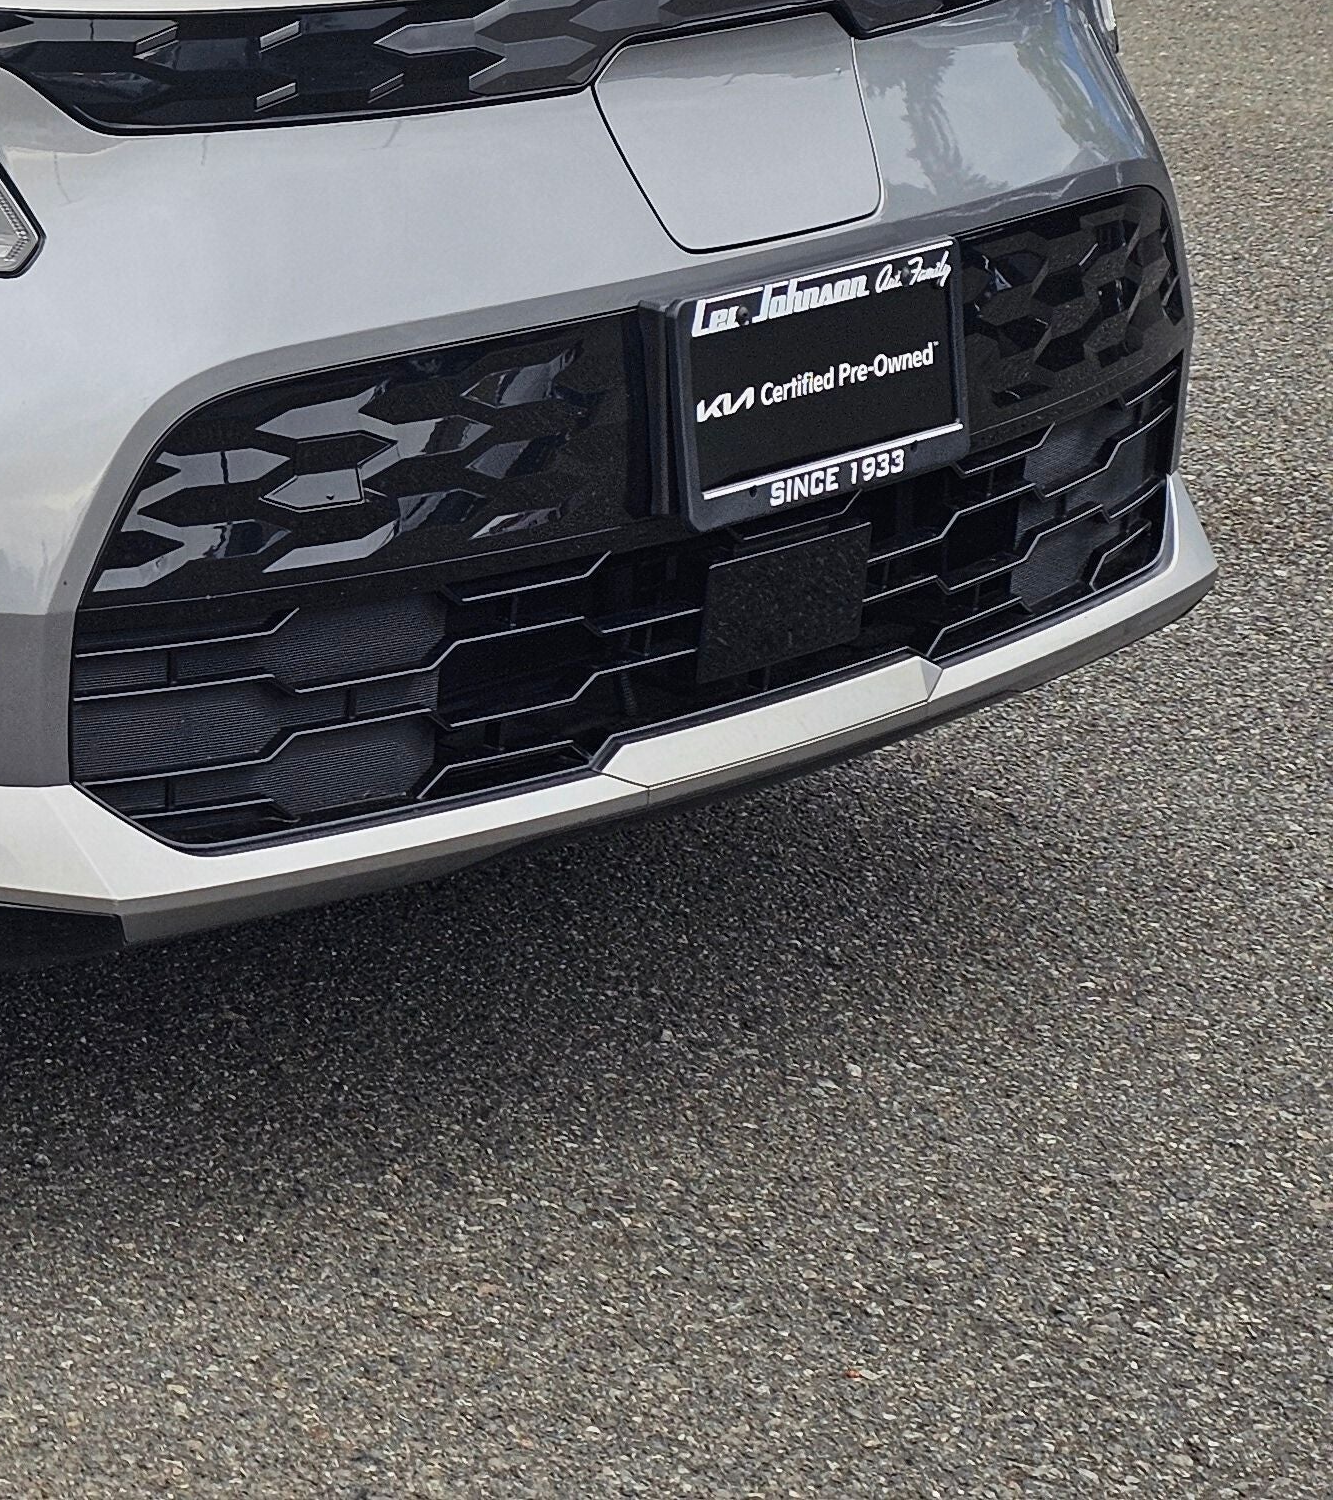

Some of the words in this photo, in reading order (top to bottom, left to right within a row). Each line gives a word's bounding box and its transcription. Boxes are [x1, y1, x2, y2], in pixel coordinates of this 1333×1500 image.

[752, 275, 870, 324] Johnson
[875, 263, 905, 293] Aut
[908, 250, 952, 287] Family
[696, 386, 755, 423] KIA
[760, 366, 835, 406] Certified
[838, 341, 934, 386] Pre-Owned
[770, 466, 840, 507] SINCE
[851, 448, 905, 485] 1933
